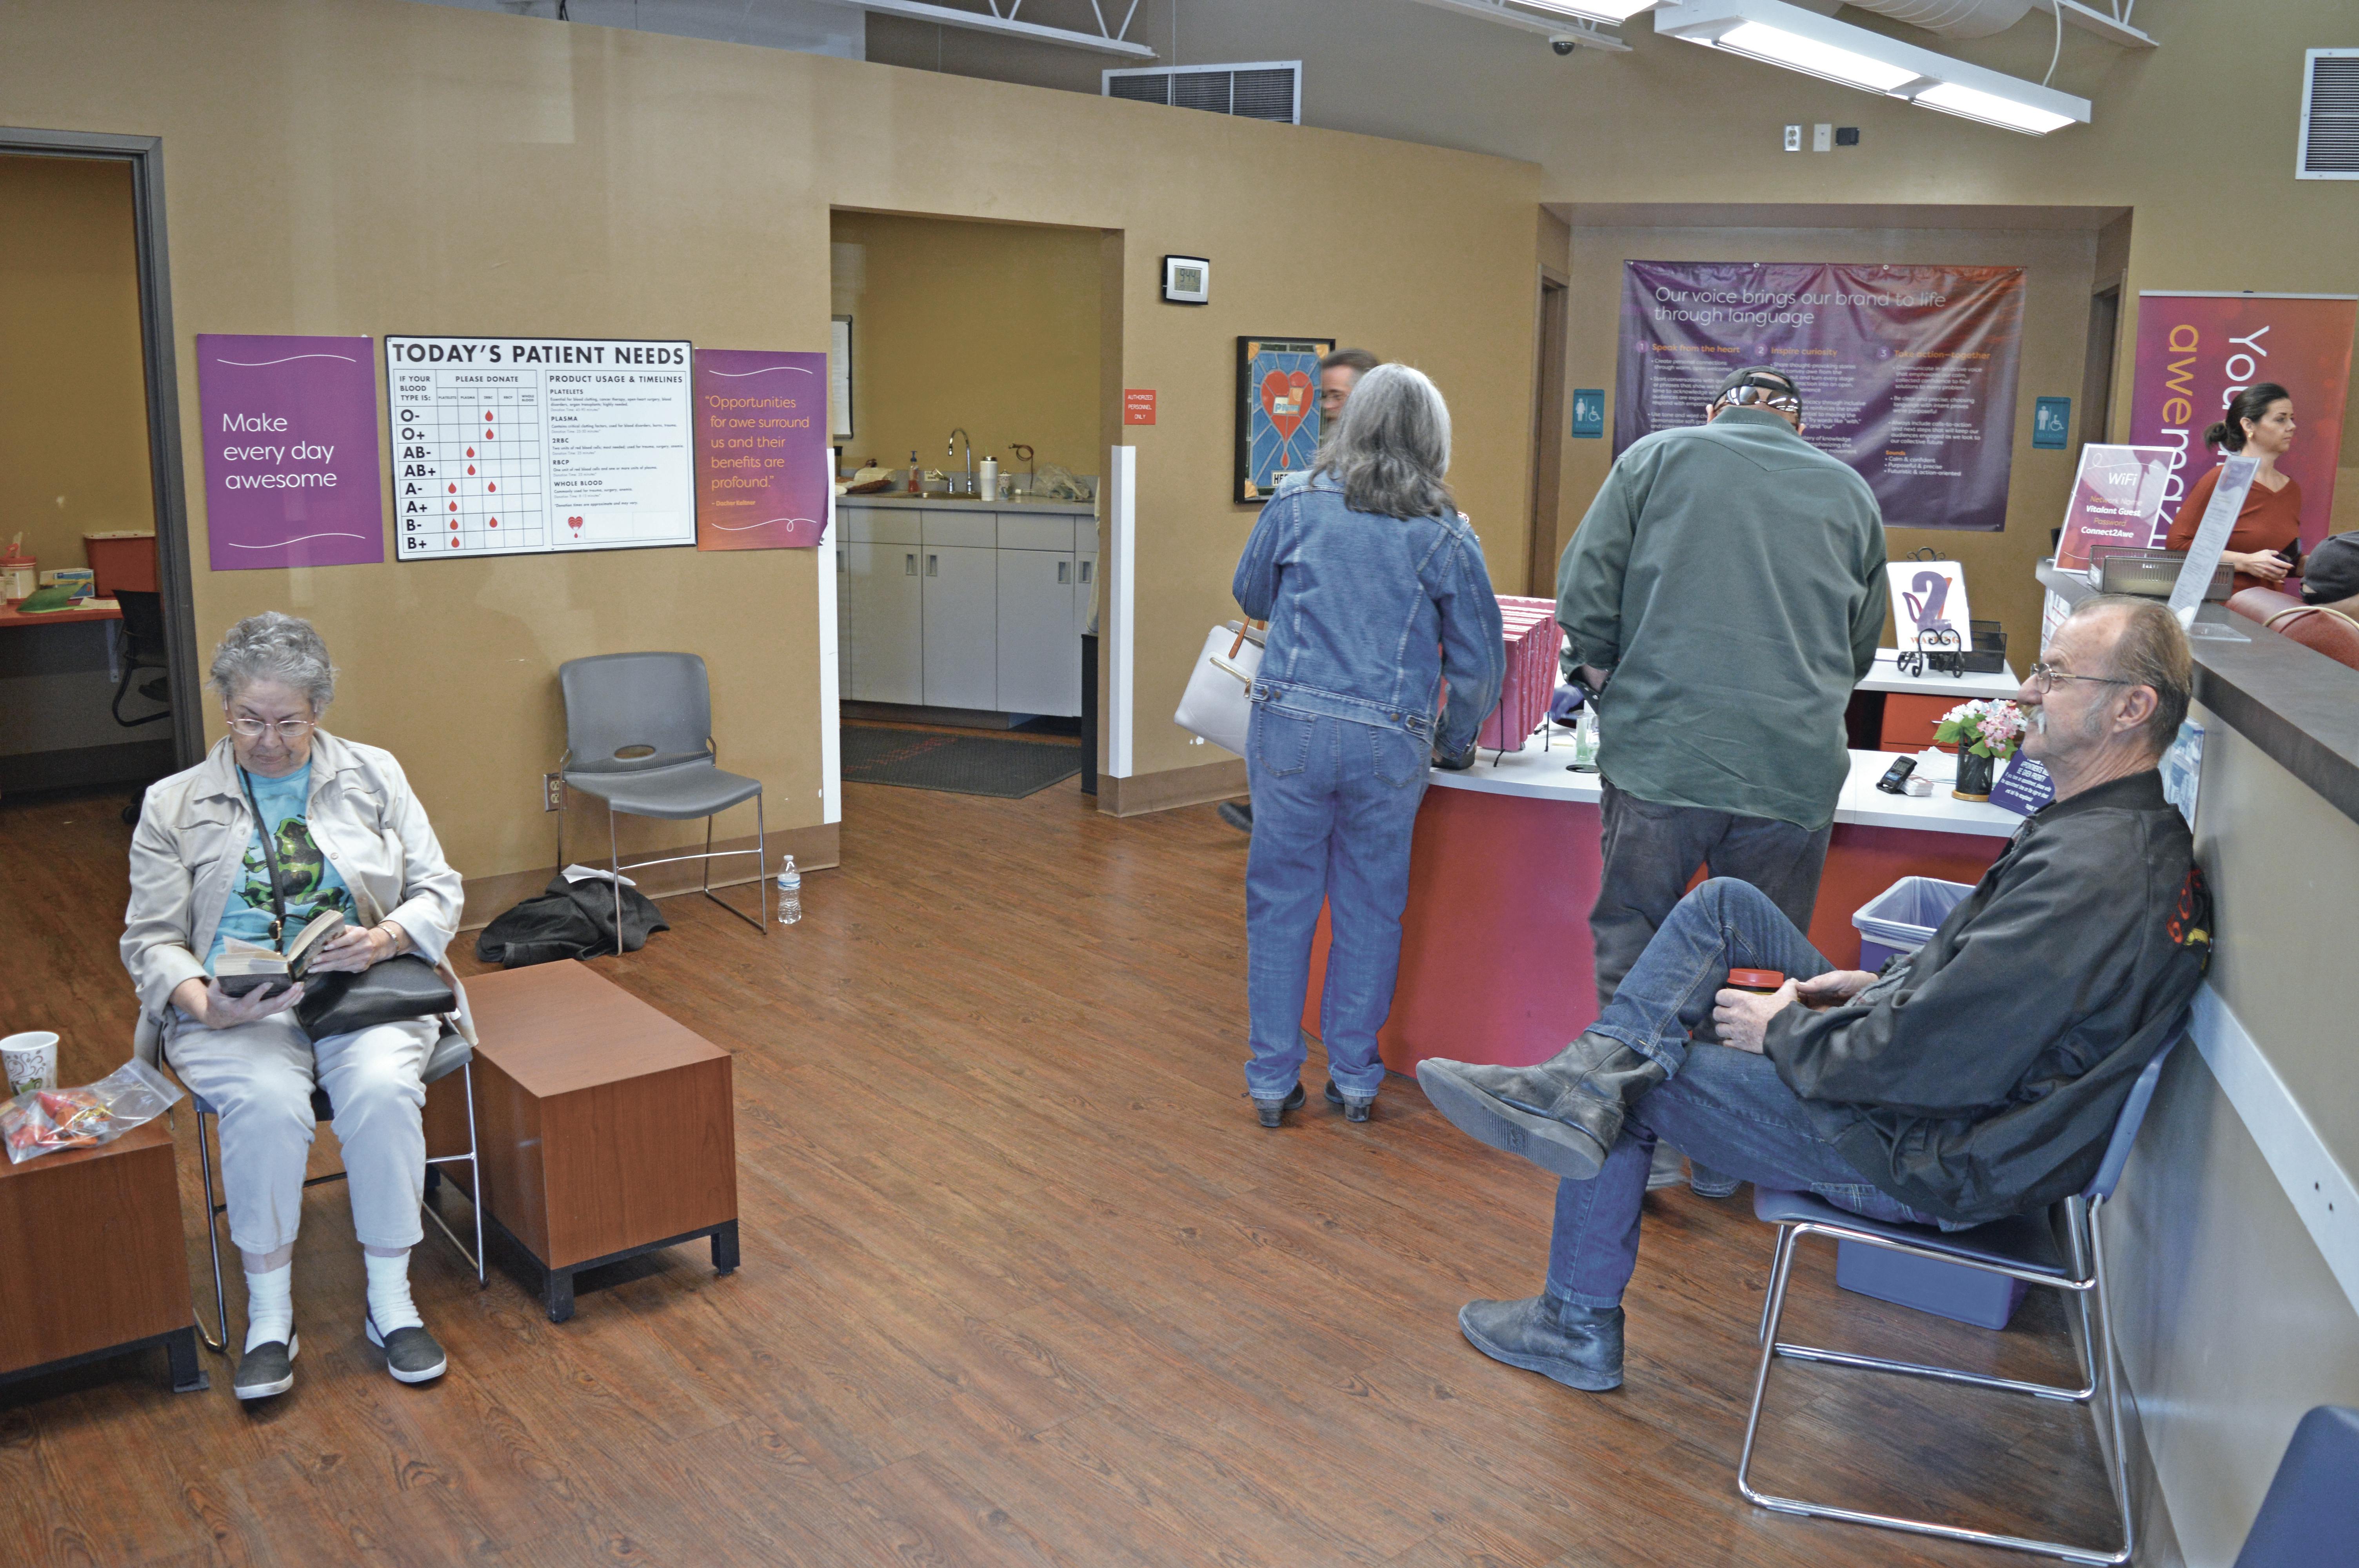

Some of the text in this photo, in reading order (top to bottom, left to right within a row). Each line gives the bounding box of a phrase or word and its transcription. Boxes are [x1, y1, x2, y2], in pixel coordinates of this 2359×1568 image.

[1655, 285, 1946, 309] Our voice brings our brand to life
[1654, 306, 1814, 329] through language
[1652, 343, 1677, 352] Speak
[1771, 347, 1799, 356] Inspire
[1801, 347, 1837, 357] curiosity
[393, 344, 683, 365] TODAY'S PATIENT NEEDS
[401, 409, 419, 422] O-
[711, 415, 809, 428] for awe surround
[224, 413, 287, 432] Make
[402, 428, 424, 440] O+
[711, 436, 785, 448] us and their
[224, 441, 334, 465] every day
[403, 446, 431, 459] AB-
[711, 456, 784, 468] benefits are
[405, 465, 436, 477] AB+
[226, 474, 336, 489] awesome
[2109, 473, 2138, 486] WiFi
[405, 483, 422, 495] A-
[407, 501, 427, 513] A+
[2086, 505, 2117, 514] Vitalant
[407, 519, 421, 531] B-
[2094, 517, 2127, 526] Password
[2081, 526, 2134, 538] Connect2Awe
[408, 537, 426, 549] B+
[1912, 571, 1952, 631] 2
